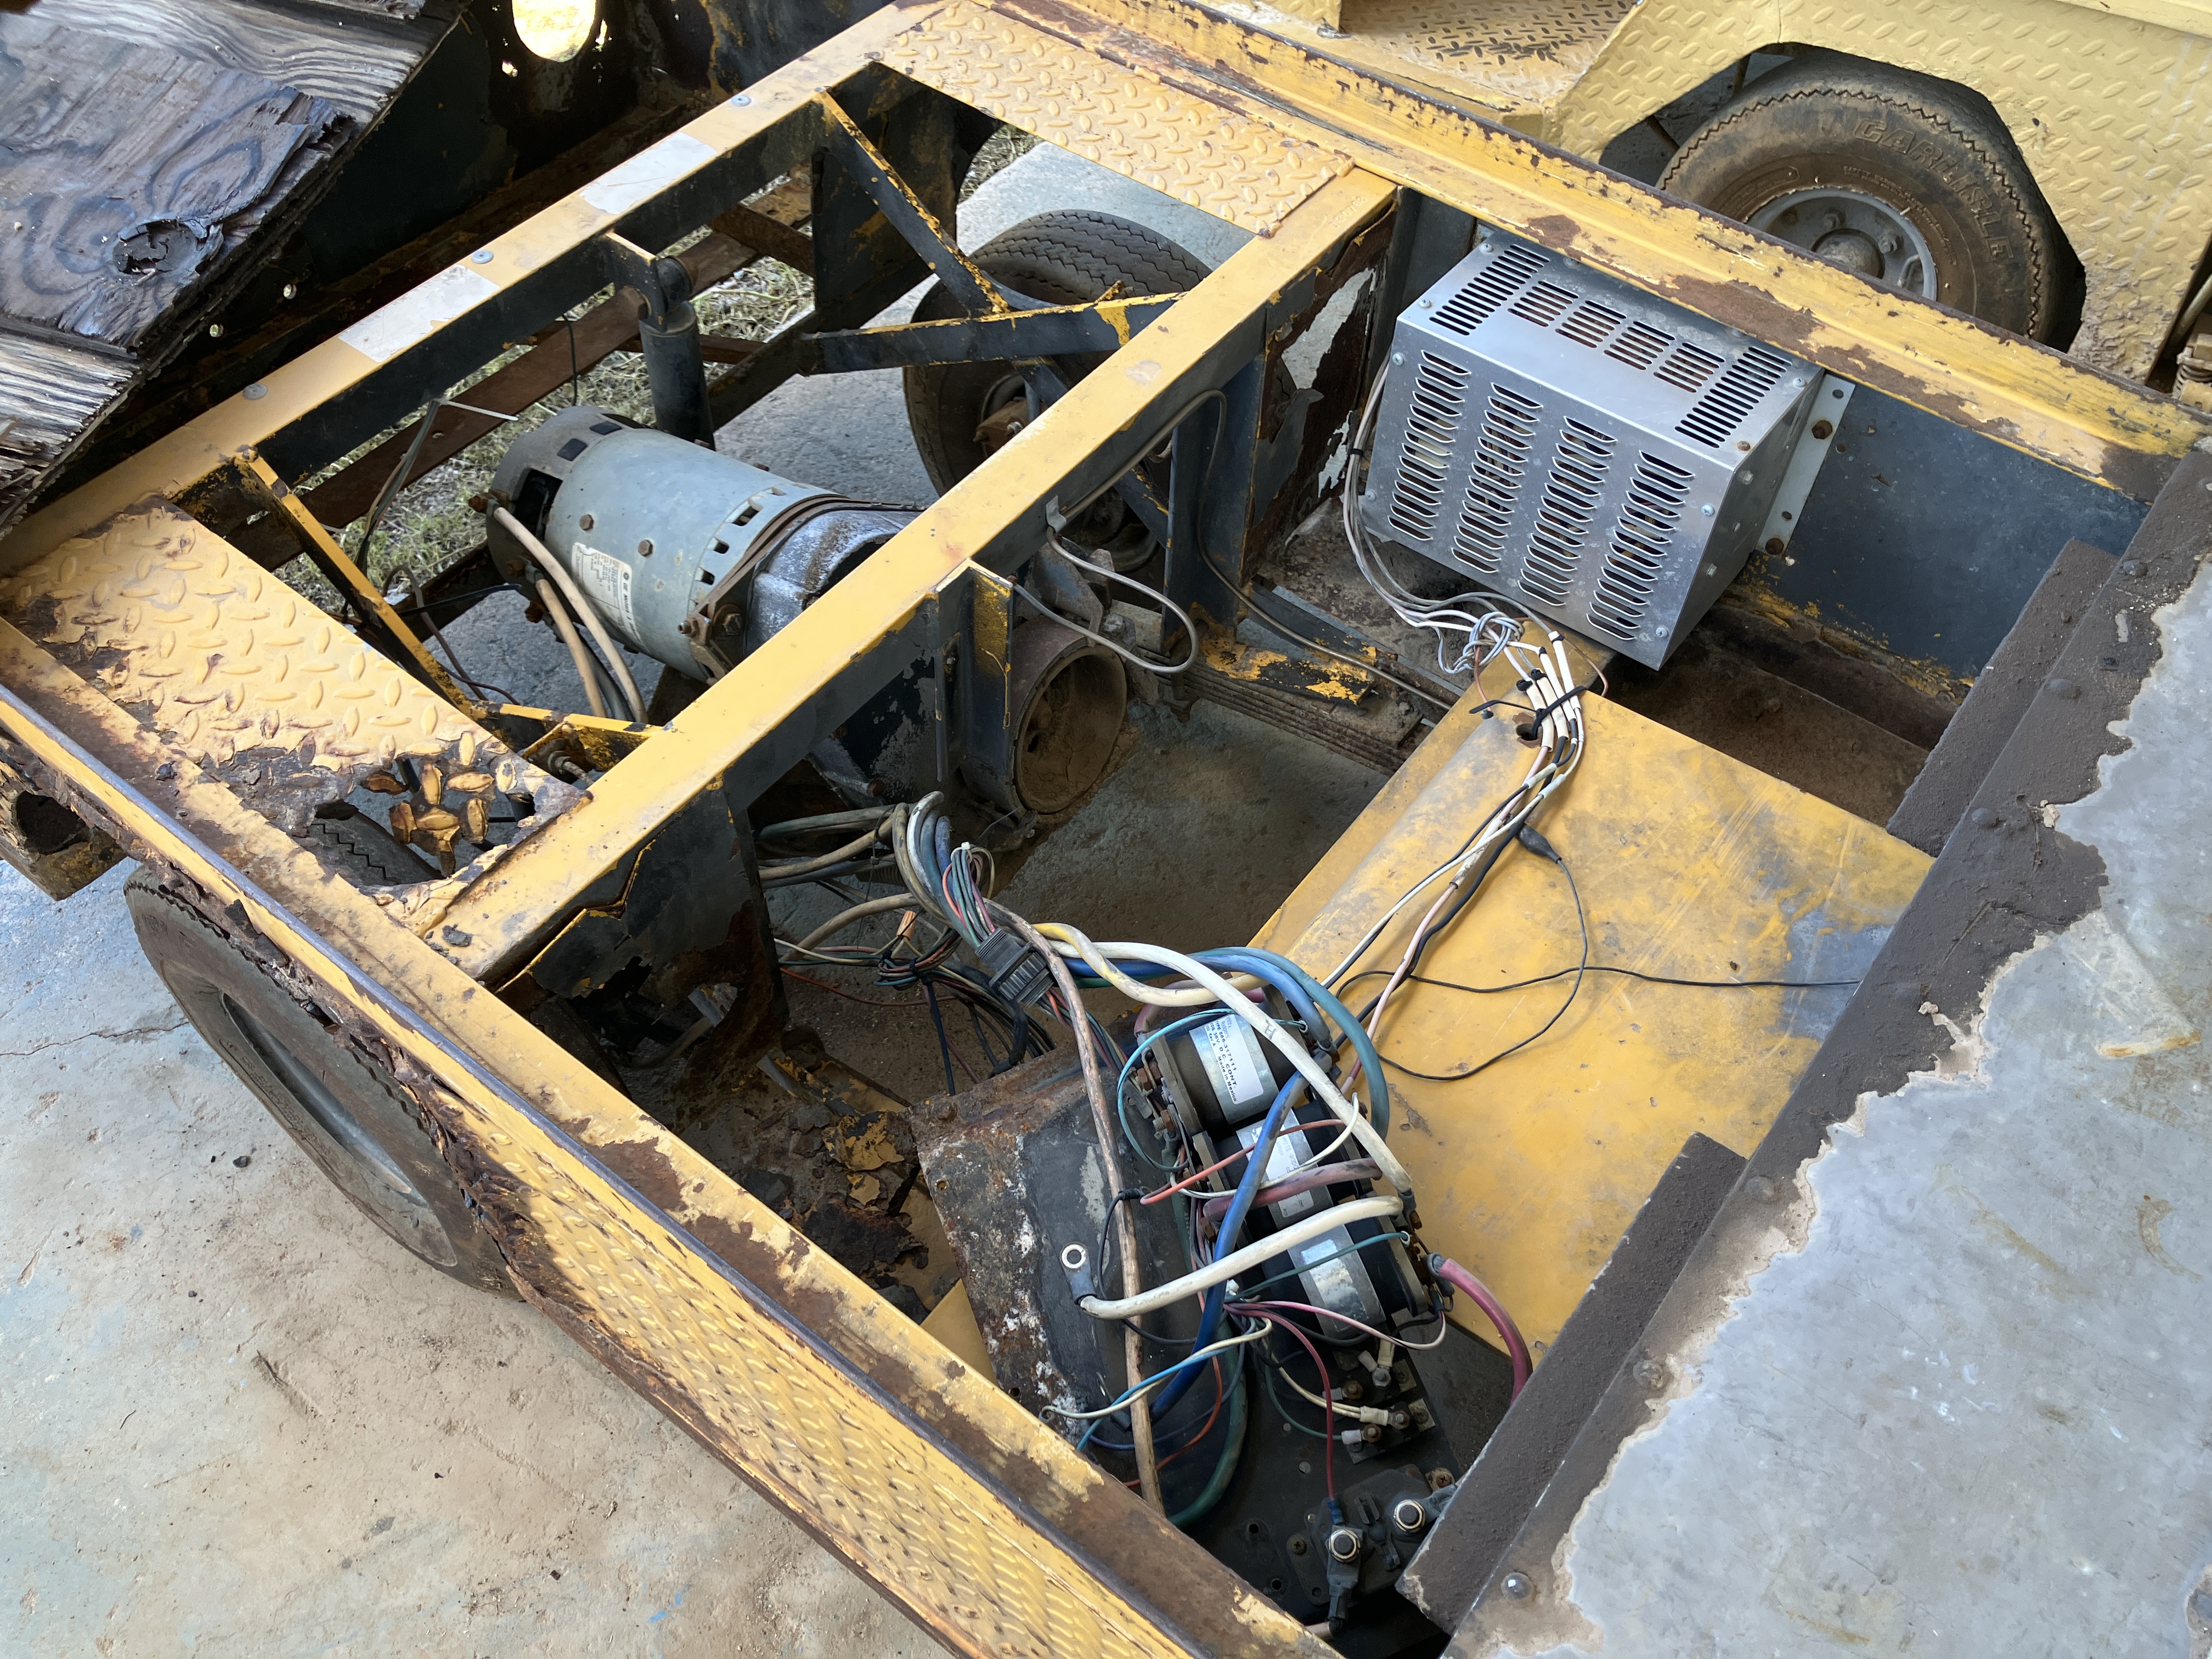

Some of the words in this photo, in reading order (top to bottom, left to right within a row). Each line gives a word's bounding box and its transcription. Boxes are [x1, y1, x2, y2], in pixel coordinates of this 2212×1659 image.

[1853, 117, 2015, 259] CARLISLE
[1217, 1056, 1226, 1073] Made
[1226, 1081, 1237, 1102] Mexico
